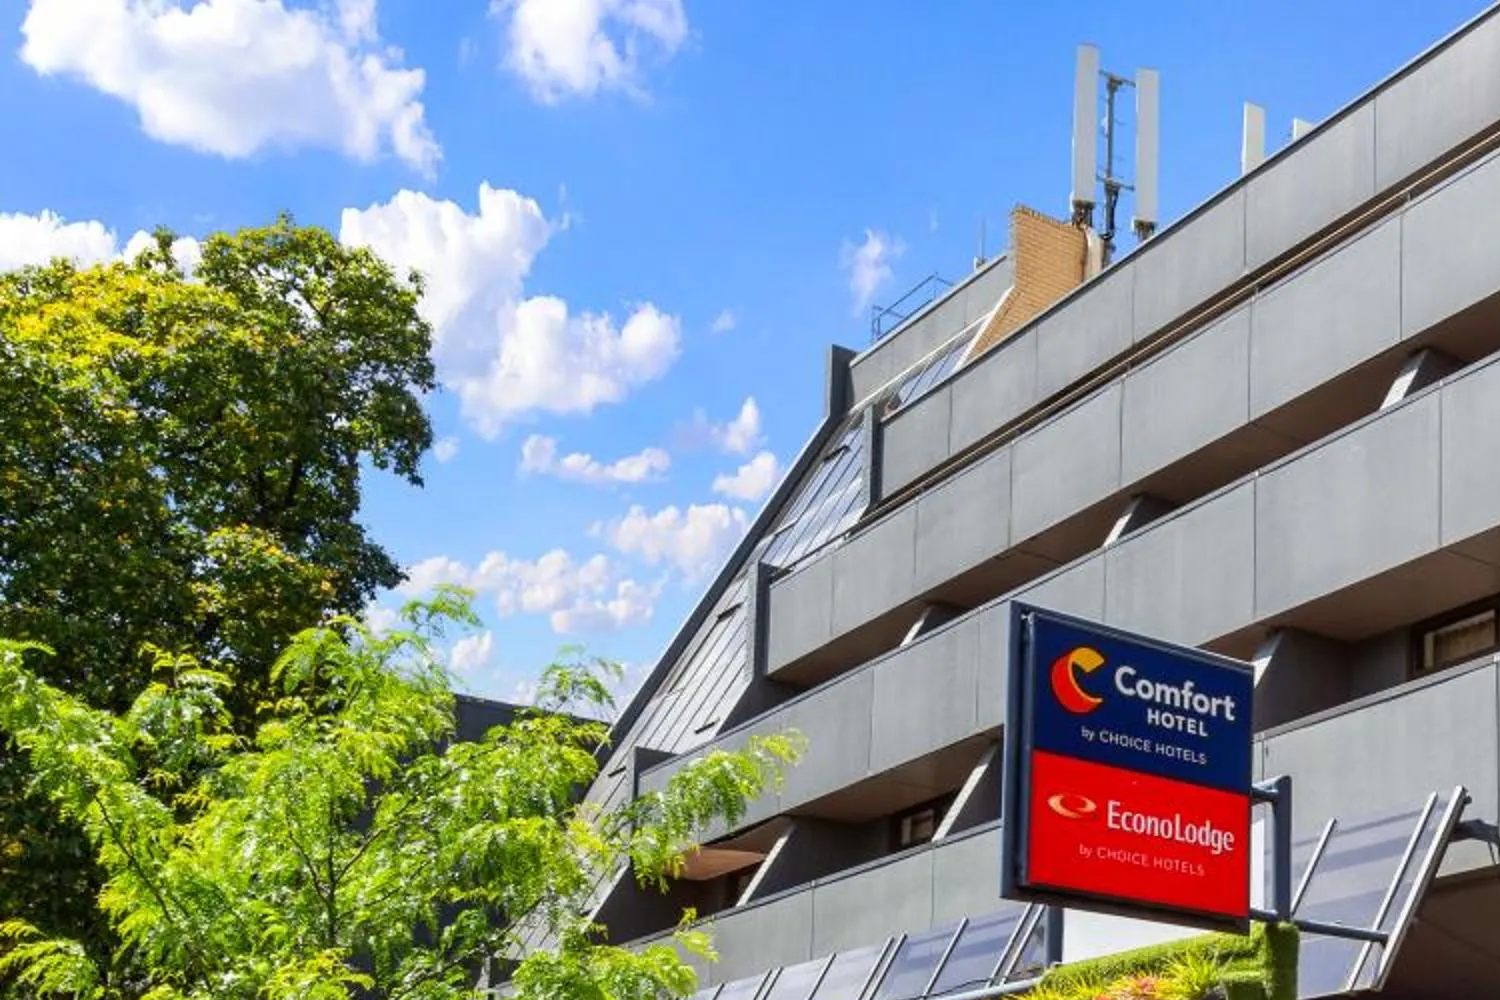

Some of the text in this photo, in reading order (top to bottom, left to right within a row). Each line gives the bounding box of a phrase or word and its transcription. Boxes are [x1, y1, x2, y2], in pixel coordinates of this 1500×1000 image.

[1115, 666, 1236, 721] Comfort
[1147, 708, 1208, 737] HOTEL
[1081, 726, 1208, 765] by CHOICE HOTELS
[1107, 800, 1236, 855] EconoLodge
[1079, 844, 1206, 877] by CHOICE HOTELS
